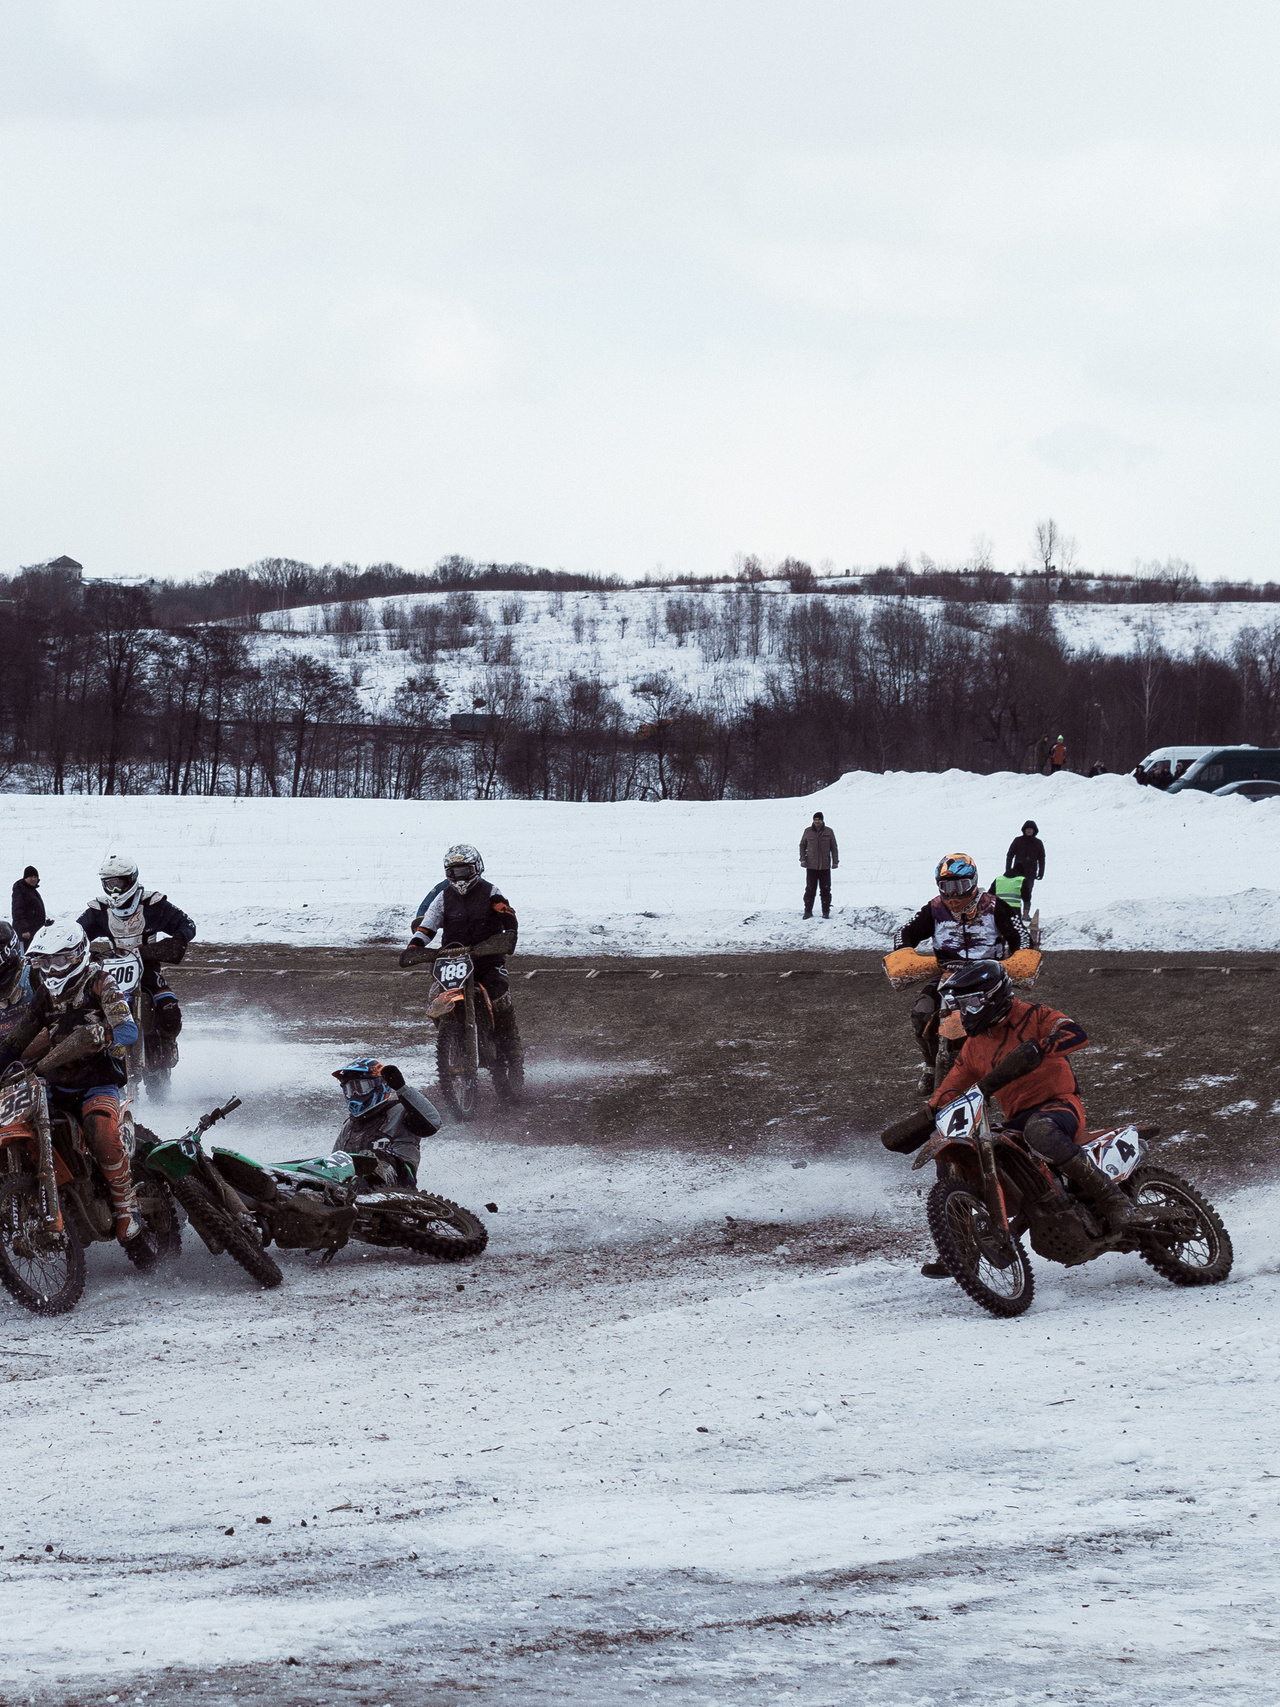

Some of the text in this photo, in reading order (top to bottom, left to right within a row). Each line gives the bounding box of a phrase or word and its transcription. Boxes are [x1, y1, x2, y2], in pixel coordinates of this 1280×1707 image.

[440, 962, 468, 982] 188
[0, 1088, 31, 1123] 32
[947, 1106, 969, 1136] 4
[1115, 1139, 1136, 1163] 4
